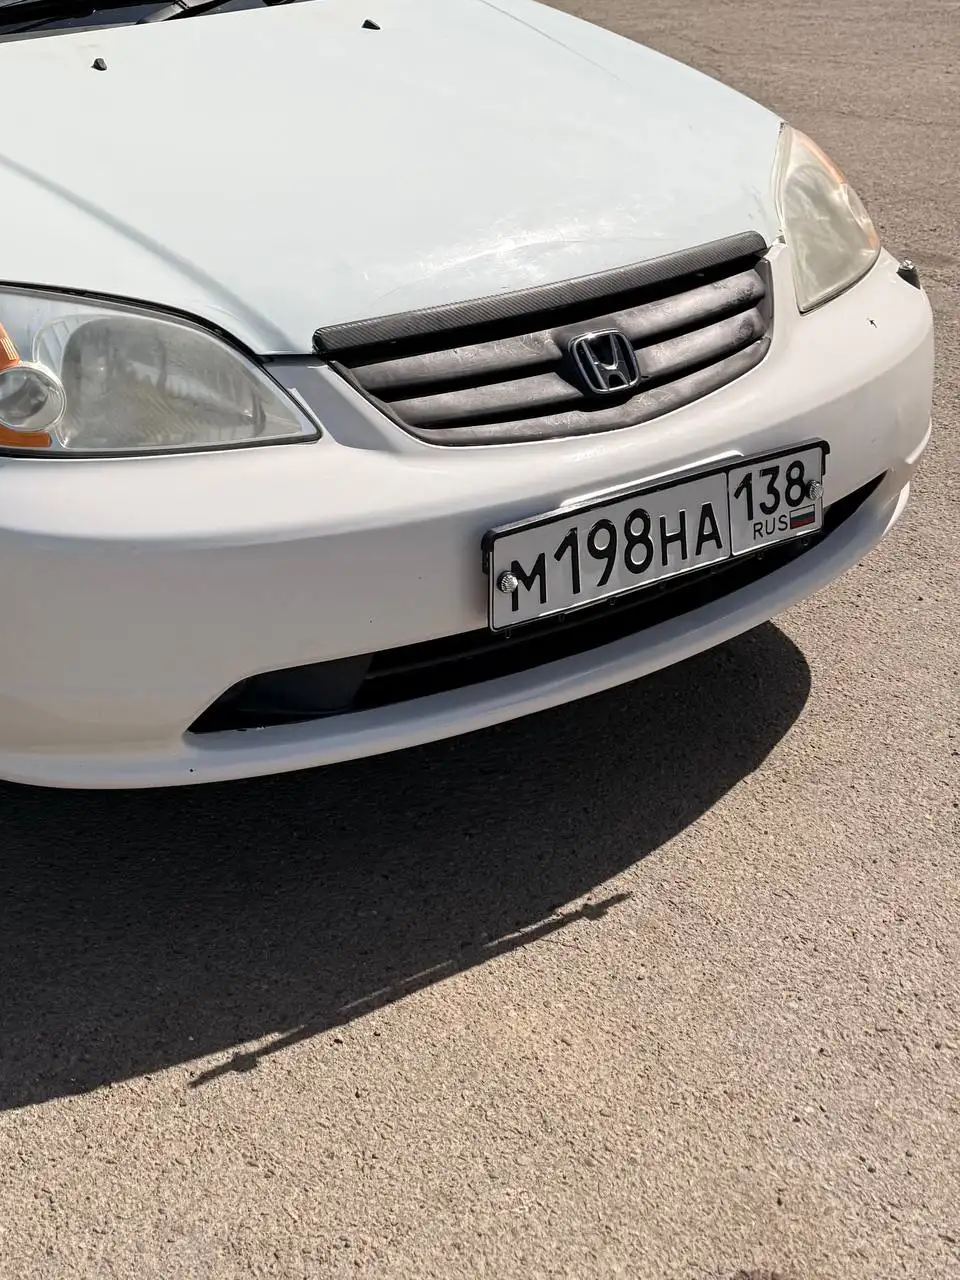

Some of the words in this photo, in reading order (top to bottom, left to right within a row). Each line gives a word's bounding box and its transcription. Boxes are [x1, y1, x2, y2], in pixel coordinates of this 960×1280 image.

[510, 502, 723, 612] М198НА
[733, 460, 806, 521] 138
[752, 514, 789, 540] RUS
